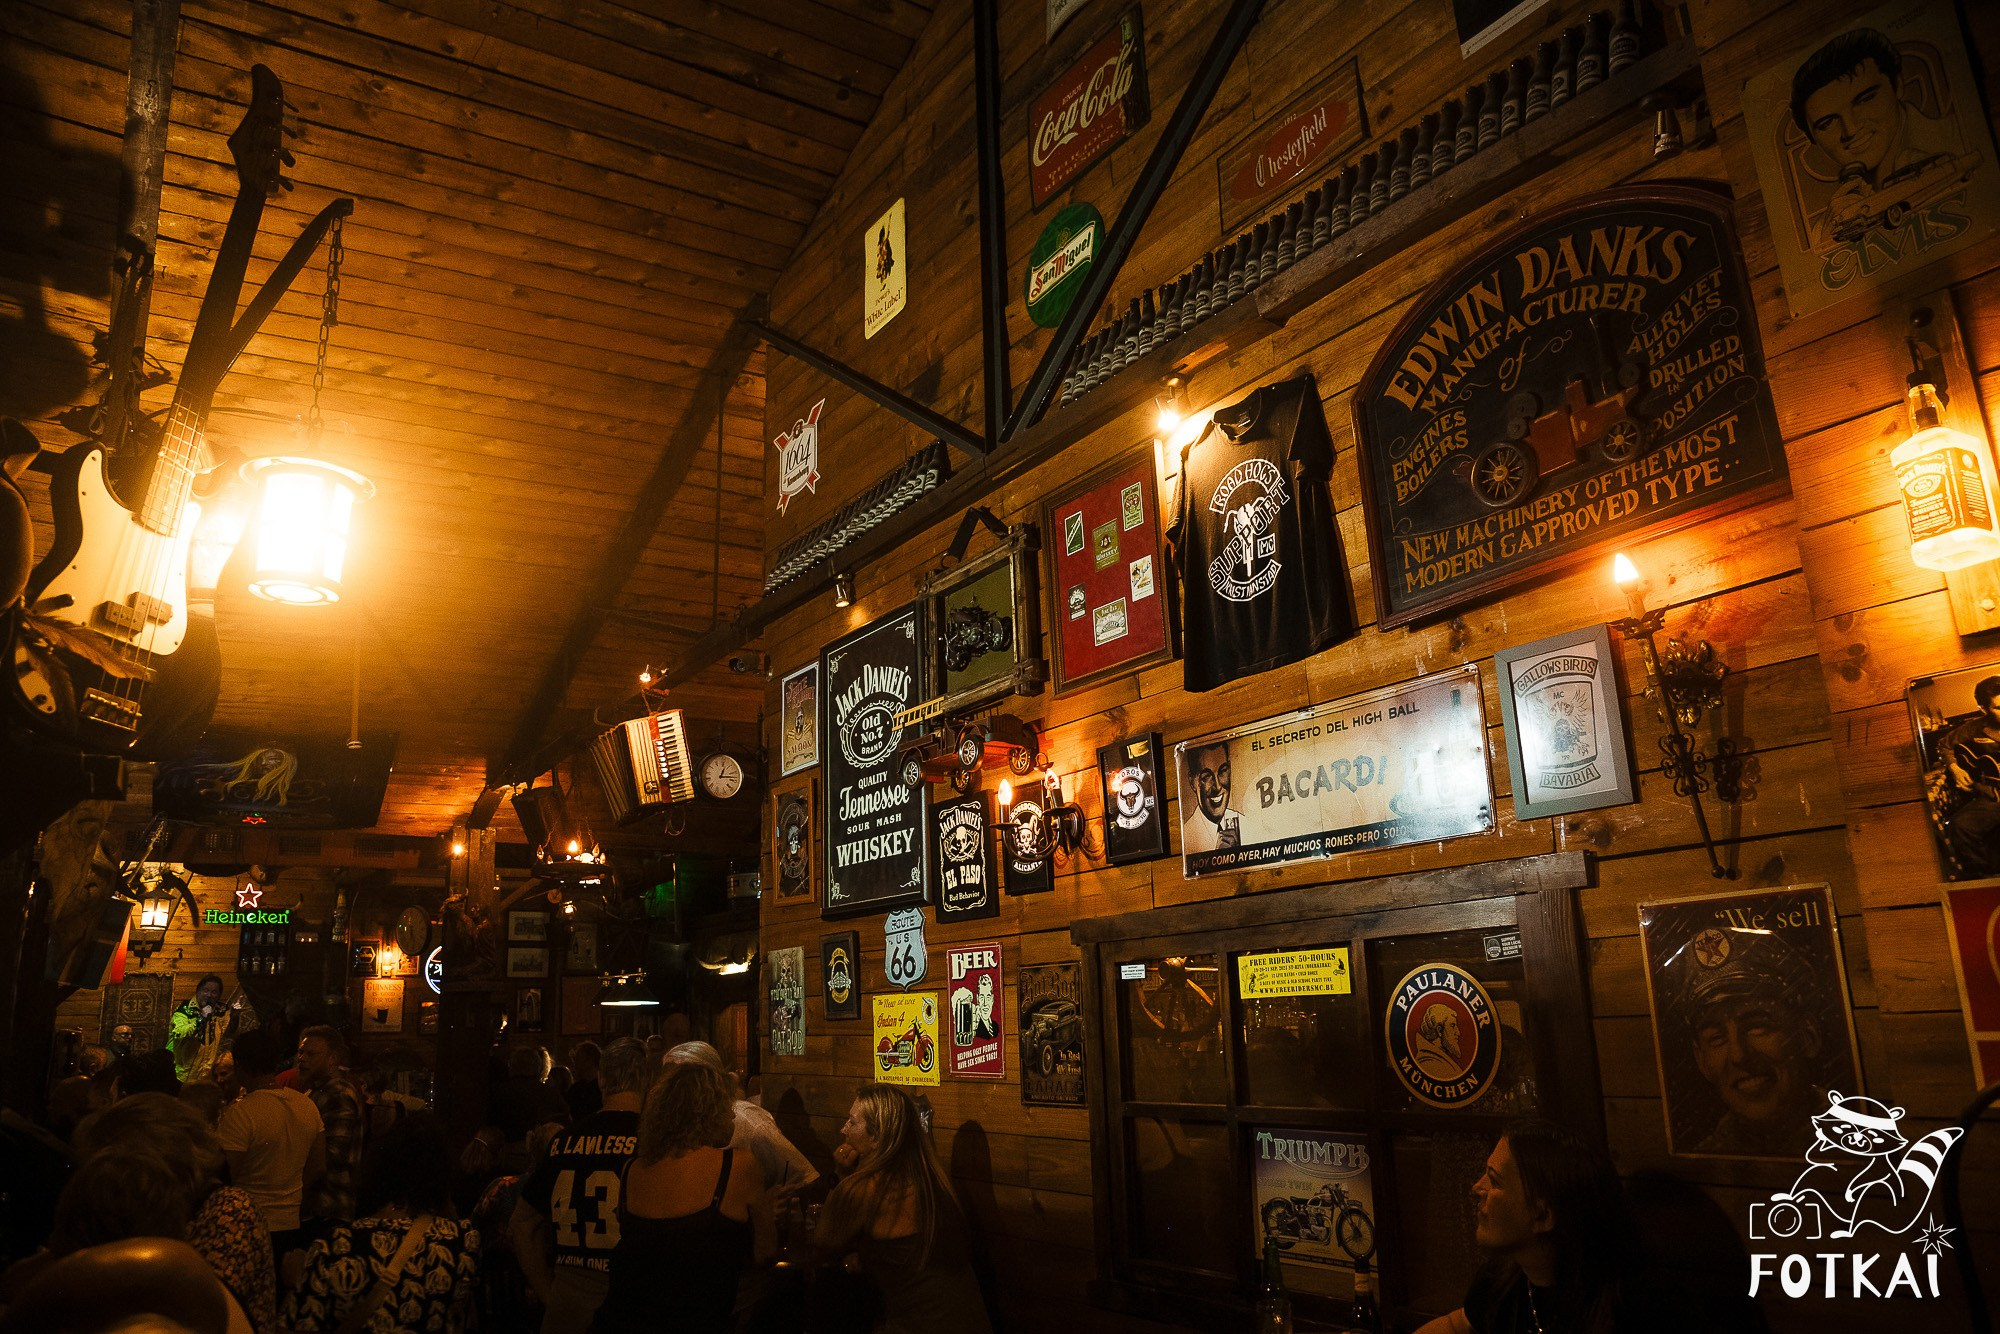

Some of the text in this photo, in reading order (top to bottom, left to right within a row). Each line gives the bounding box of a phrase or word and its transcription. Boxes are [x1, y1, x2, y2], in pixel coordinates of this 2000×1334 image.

[1033, 36, 1135, 167] Coca-Cola
[1256, 107, 1327, 188] Chesterfield
[1820, 189, 1971, 292] ELVIS
[1031, 232, 1091, 298] San Miguel
[1384, 224, 1699, 411] EDWIN DANKS
[1626, 269, 1723, 354] ALL RIVET
[1648, 291, 1722, 366] HOLES
[1420, 283, 1646, 416] MANUFACTURER
[1650, 335, 1740, 388] DRILLED
[1392, 410, 1467, 481] ENGINES
[1396, 429, 1468, 501] BOILERS
[1214, 462, 1276, 507] ROAD HOGS
[1401, 414, 1739, 569] NEW MACHINERY OF THE MOST
[1208, 477, 1290, 589] SUPPORT
[1260, 538, 1274, 554] MC
[1405, 540, 1494, 593] MODERN
[1517, 658, 1596, 692] GALLOWS BIRDS
[835, 677, 864, 726] JACK
[863, 663, 911, 702] DANIEL'S
[1553, 691, 1565, 700] MC
[862, 713, 881, 731] Old
[1251, 701, 1420, 752] EL SECRETO DEL HIGH BALL
[862, 741, 883, 754] BRAND
[858, 770, 888, 790] QUALITY
[1255, 754, 1388, 811] BACARDI
[1543, 766, 1595, 786] BAVARIA
[839, 784, 910, 821] Tennessee
[847, 813, 902, 835] SOUR MASH
[940, 808, 982, 839] JACK DANIEL'S
[836, 827, 915, 868] WHISKEY
[1192, 857, 1209, 870] HOY
[1211, 853, 1235, 867] COMO
[1283, 838, 1322, 855] MUCHOS
[945, 864, 980, 890] EL PASO
[959, 891, 980, 901] Behavior
[205, 909, 290, 925] Heineken
[892, 915, 915, 930] ROUTE
[1776, 901, 1821, 929] sell
[891, 943, 916, 980] 66
[951, 950, 998, 980] BEER
[1250, 958, 1267, 966] FREE
[1299, 953, 1336, 963] 50-HOURS
[366, 982, 402, 991] GUINNESS
[1260, 984, 1335, 994] WWW.FREERIDERSMC.BE
[1396, 972, 1491, 1029] PAULANER
[877, 1011, 906, 1028] Indian 4
[982, 1042, 998, 1054] PEOPLE
[1399, 1056, 1479, 1099] MÜNCHEN
[563, 1135, 638, 1157] LAWLESS
[1257, 1132, 1370, 1170] TRIUMPH
[551, 1169, 622, 1250] 43
[587, 1258, 611, 1272] ONE
